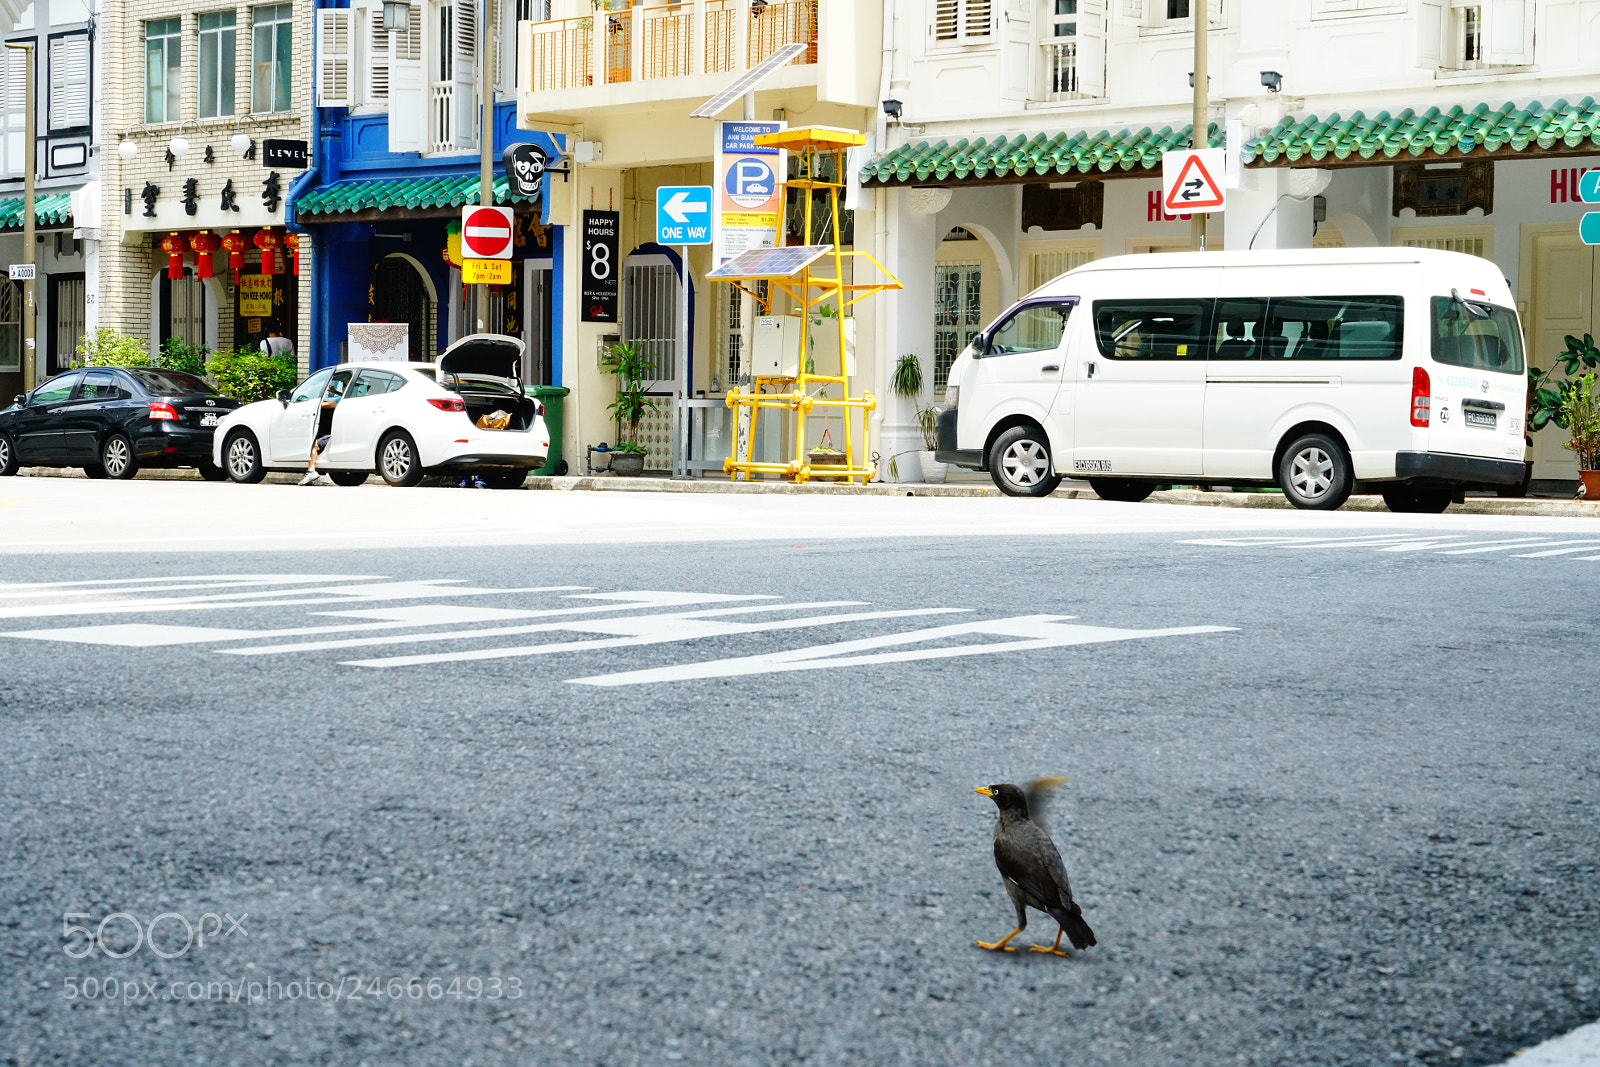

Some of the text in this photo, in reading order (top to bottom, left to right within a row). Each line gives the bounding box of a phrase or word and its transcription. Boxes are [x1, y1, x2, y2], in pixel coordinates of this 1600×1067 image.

[740, 142, 755, 150] PARK
[269, 148, 307, 159] LEVEL
[589, 218, 614, 226] HAPPY
[588, 228, 614, 236] HOURS
[661, 227, 707, 239] ONE WAY
[472, 262, 481, 270] Fri
[491, 262, 502, 270] Sat
[250, 291, 259, 301] KEE
